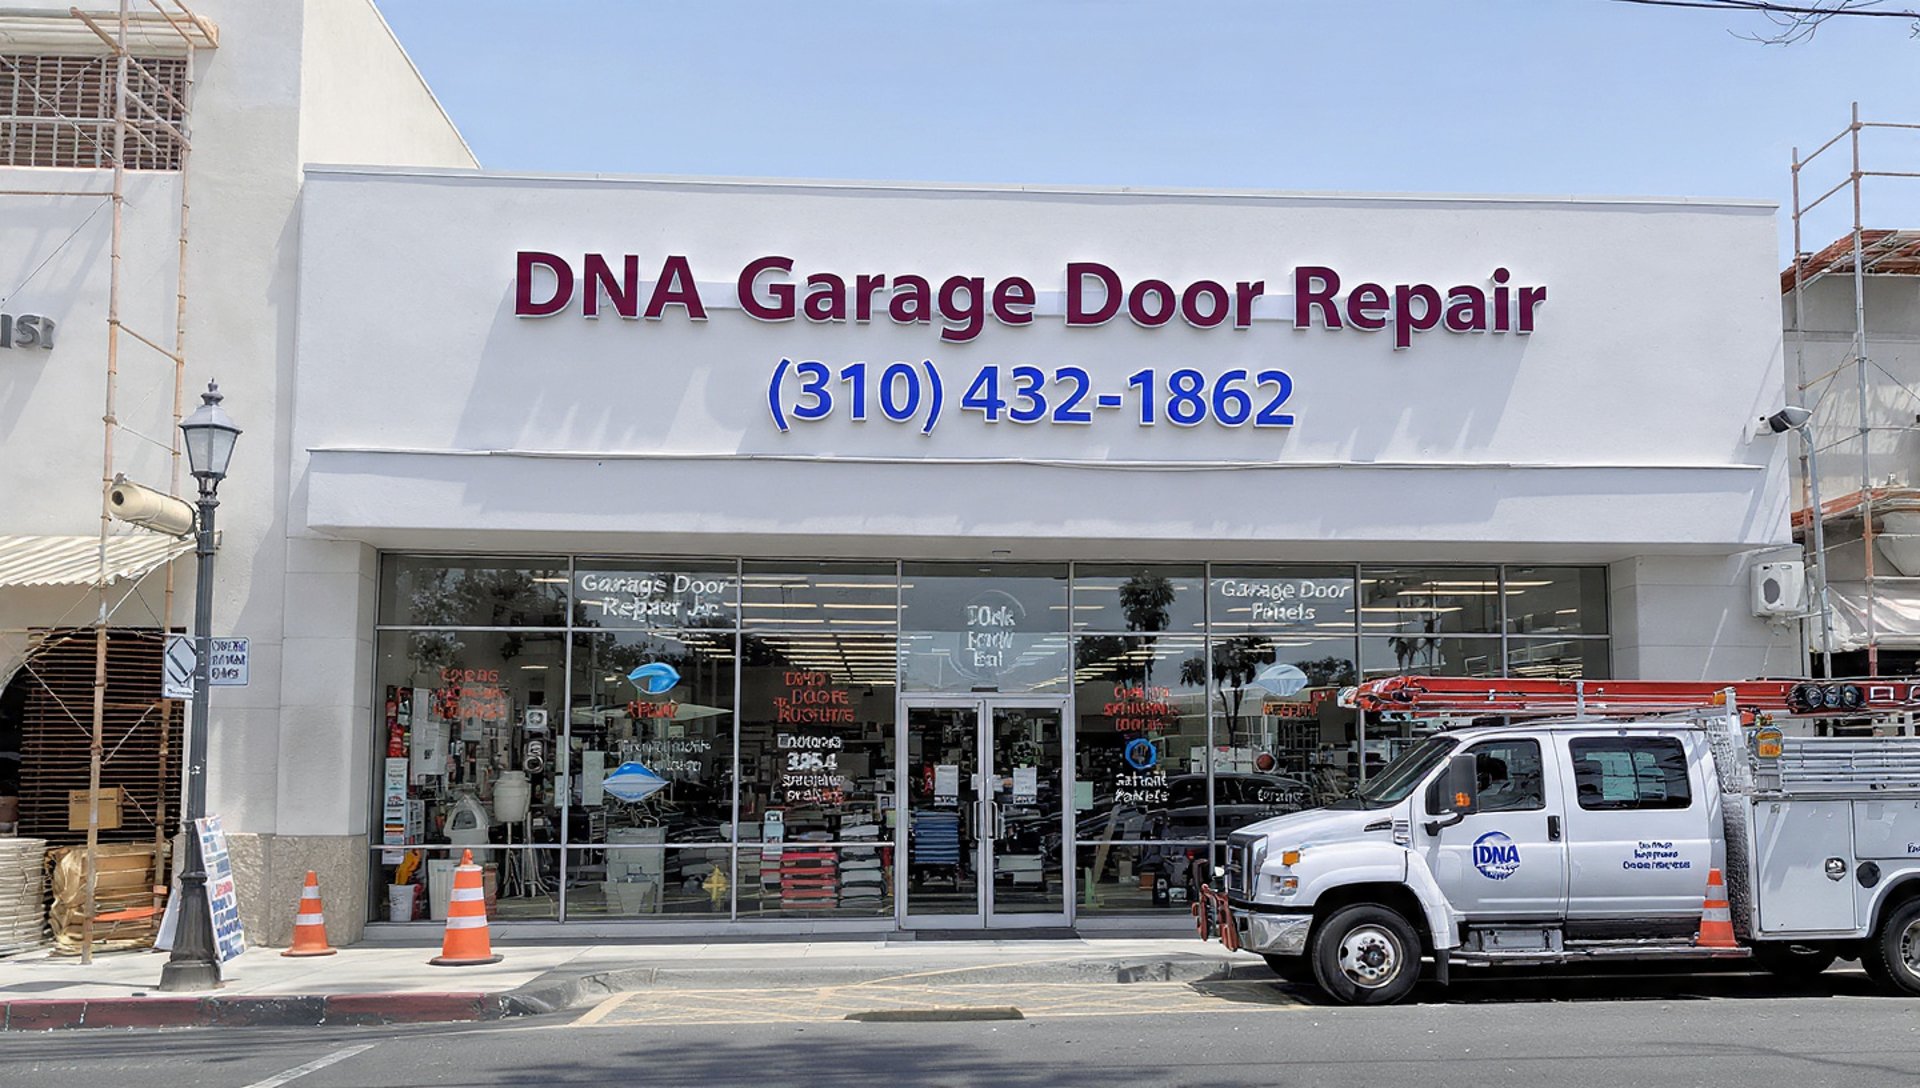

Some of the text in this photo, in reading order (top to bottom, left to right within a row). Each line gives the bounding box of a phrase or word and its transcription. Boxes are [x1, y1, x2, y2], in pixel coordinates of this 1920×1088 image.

[514, 251, 1547, 349] DNA Garage Door Repair
[767, 358, 1295, 436] (310) 432-1862
[674, 574, 728, 594] Door
[1300, 581, 1350, 598] Door
[1478, 845, 1520, 864] DNA
